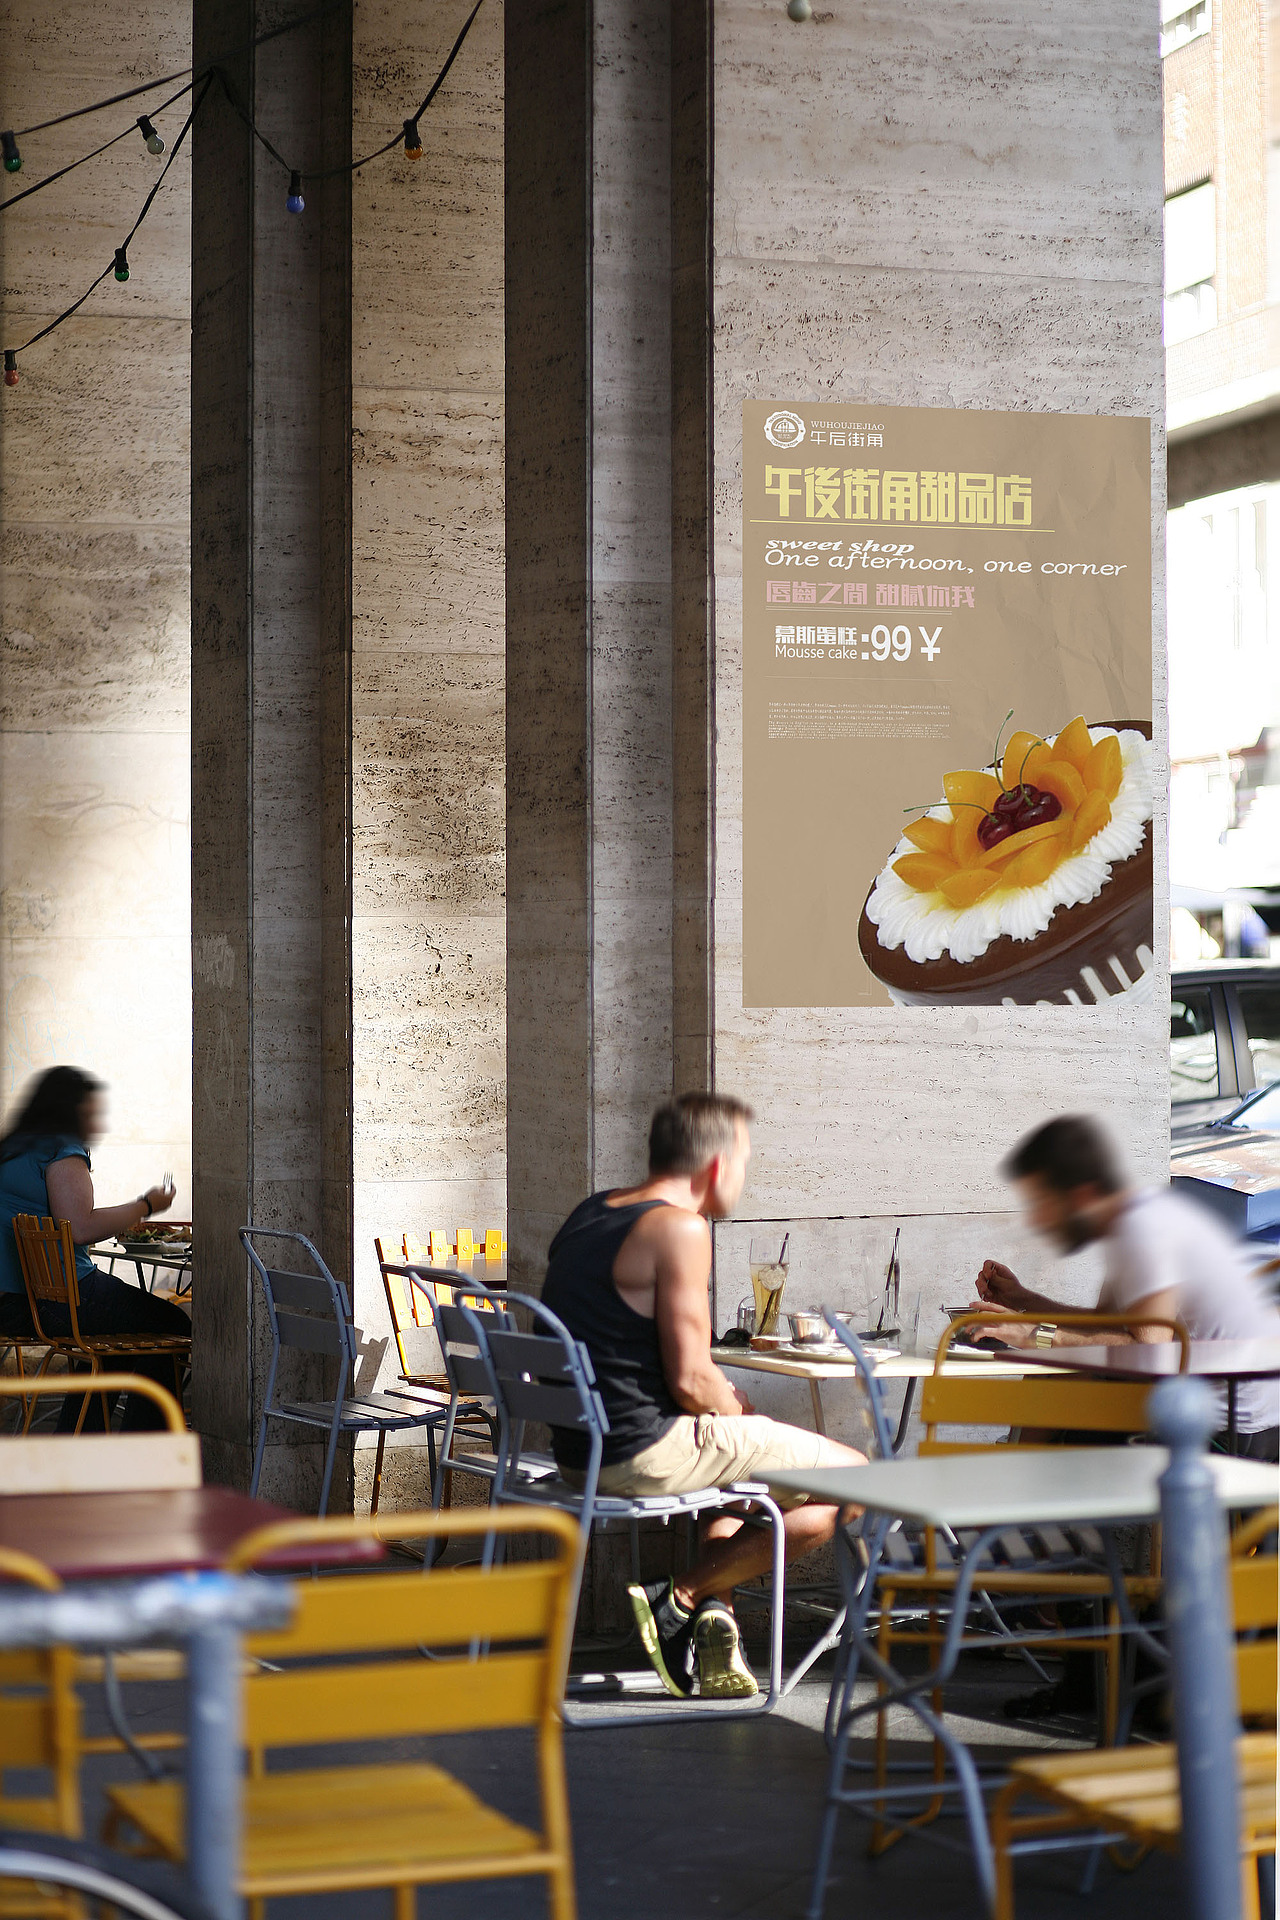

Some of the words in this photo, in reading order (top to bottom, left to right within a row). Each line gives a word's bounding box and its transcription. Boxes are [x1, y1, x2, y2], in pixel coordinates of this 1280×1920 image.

[810, 421, 885, 431] WUHOUJIEJIAO
[810, 431, 883, 448] 午后街角
[765, 464, 1032, 525] 午後街角甜品店
[766, 540, 843, 551] sweet
[849, 540, 915, 556] shop
[764, 549, 820, 567] One
[828, 552, 974, 574] afternoon,
[983, 560, 1033, 574] one
[1040, 562, 1128, 576] corner
[775, 625, 857, 646] 慕斯蛋糕
[775, 645, 825, 659] Mousse
[828, 647, 858, 660] cake
